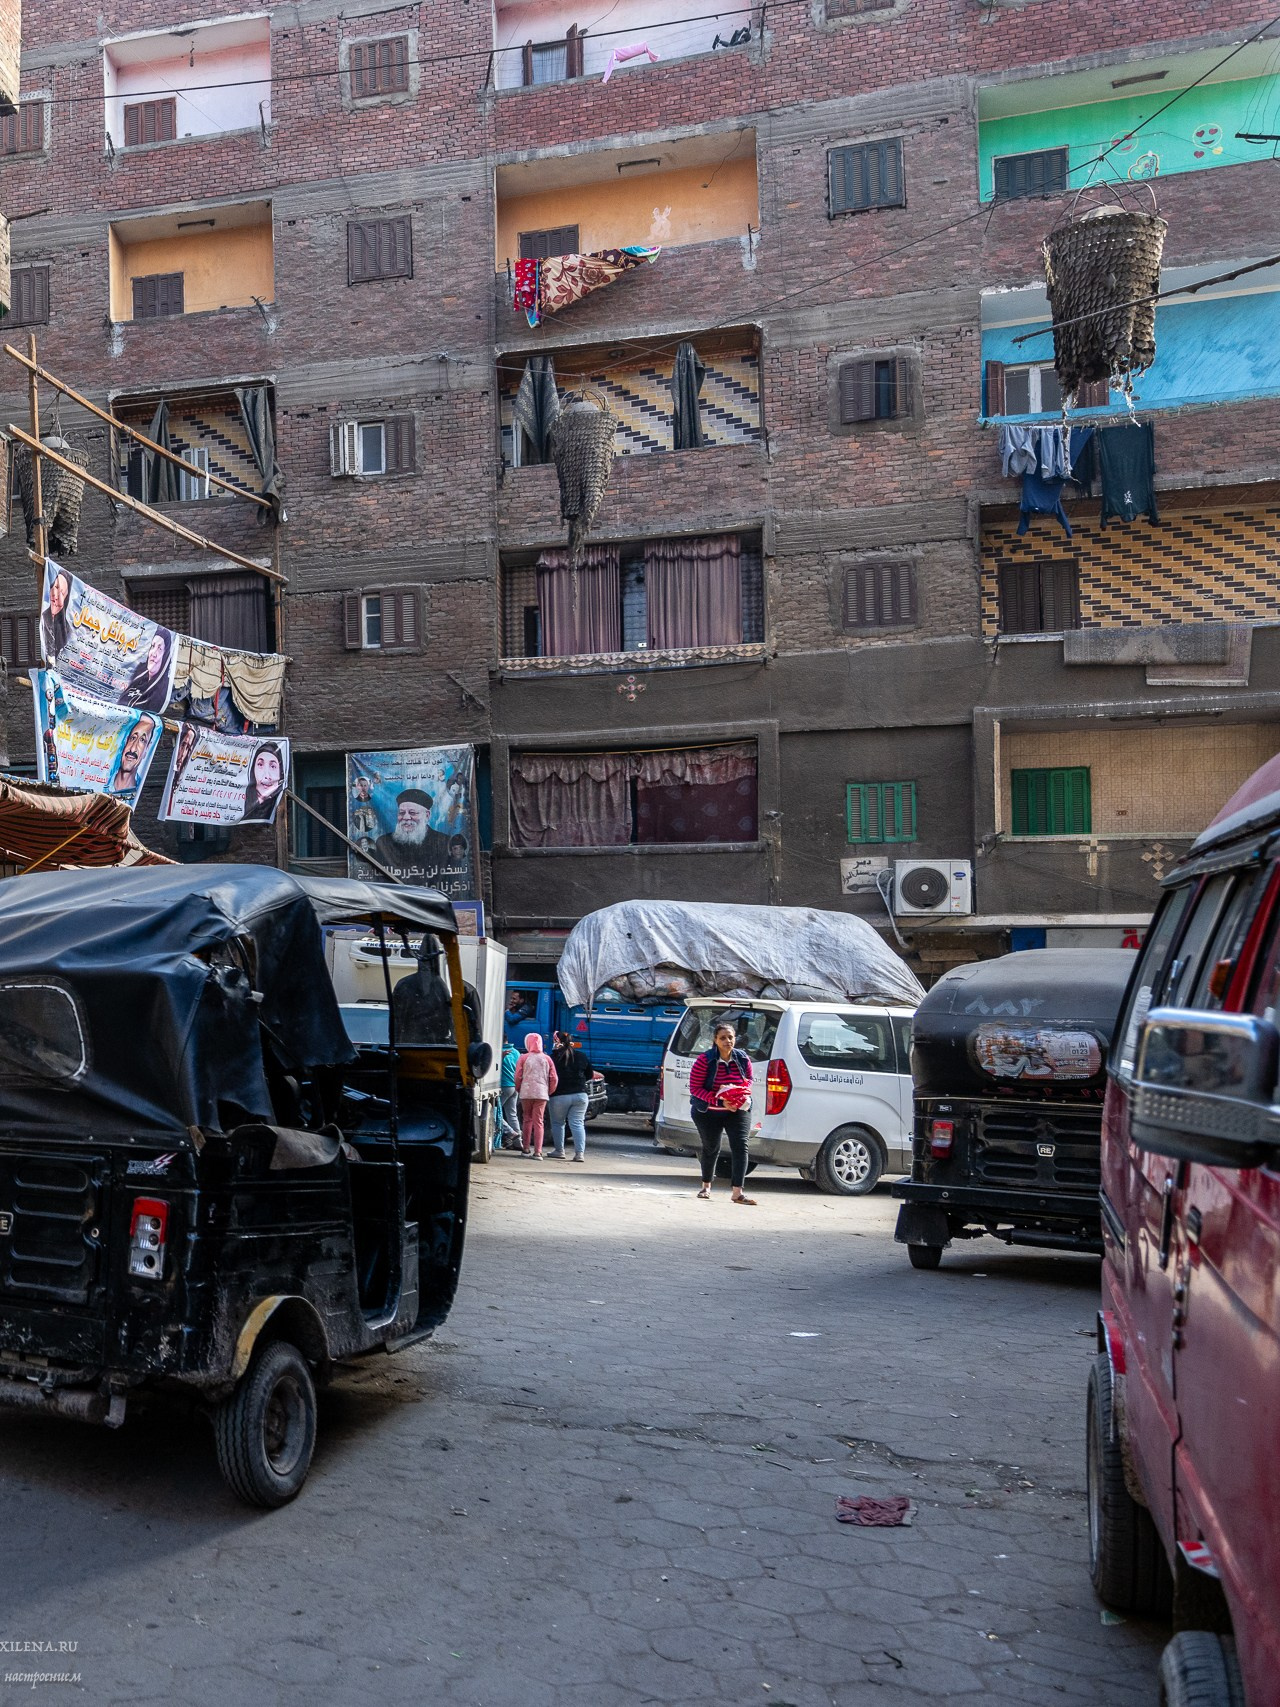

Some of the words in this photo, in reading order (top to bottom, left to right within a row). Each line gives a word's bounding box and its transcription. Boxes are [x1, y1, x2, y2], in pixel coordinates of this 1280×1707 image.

[72, 605, 101, 638] جمال
[426, 864, 439, 879] لن
[810, 1073, 828, 1082] للسياحة
